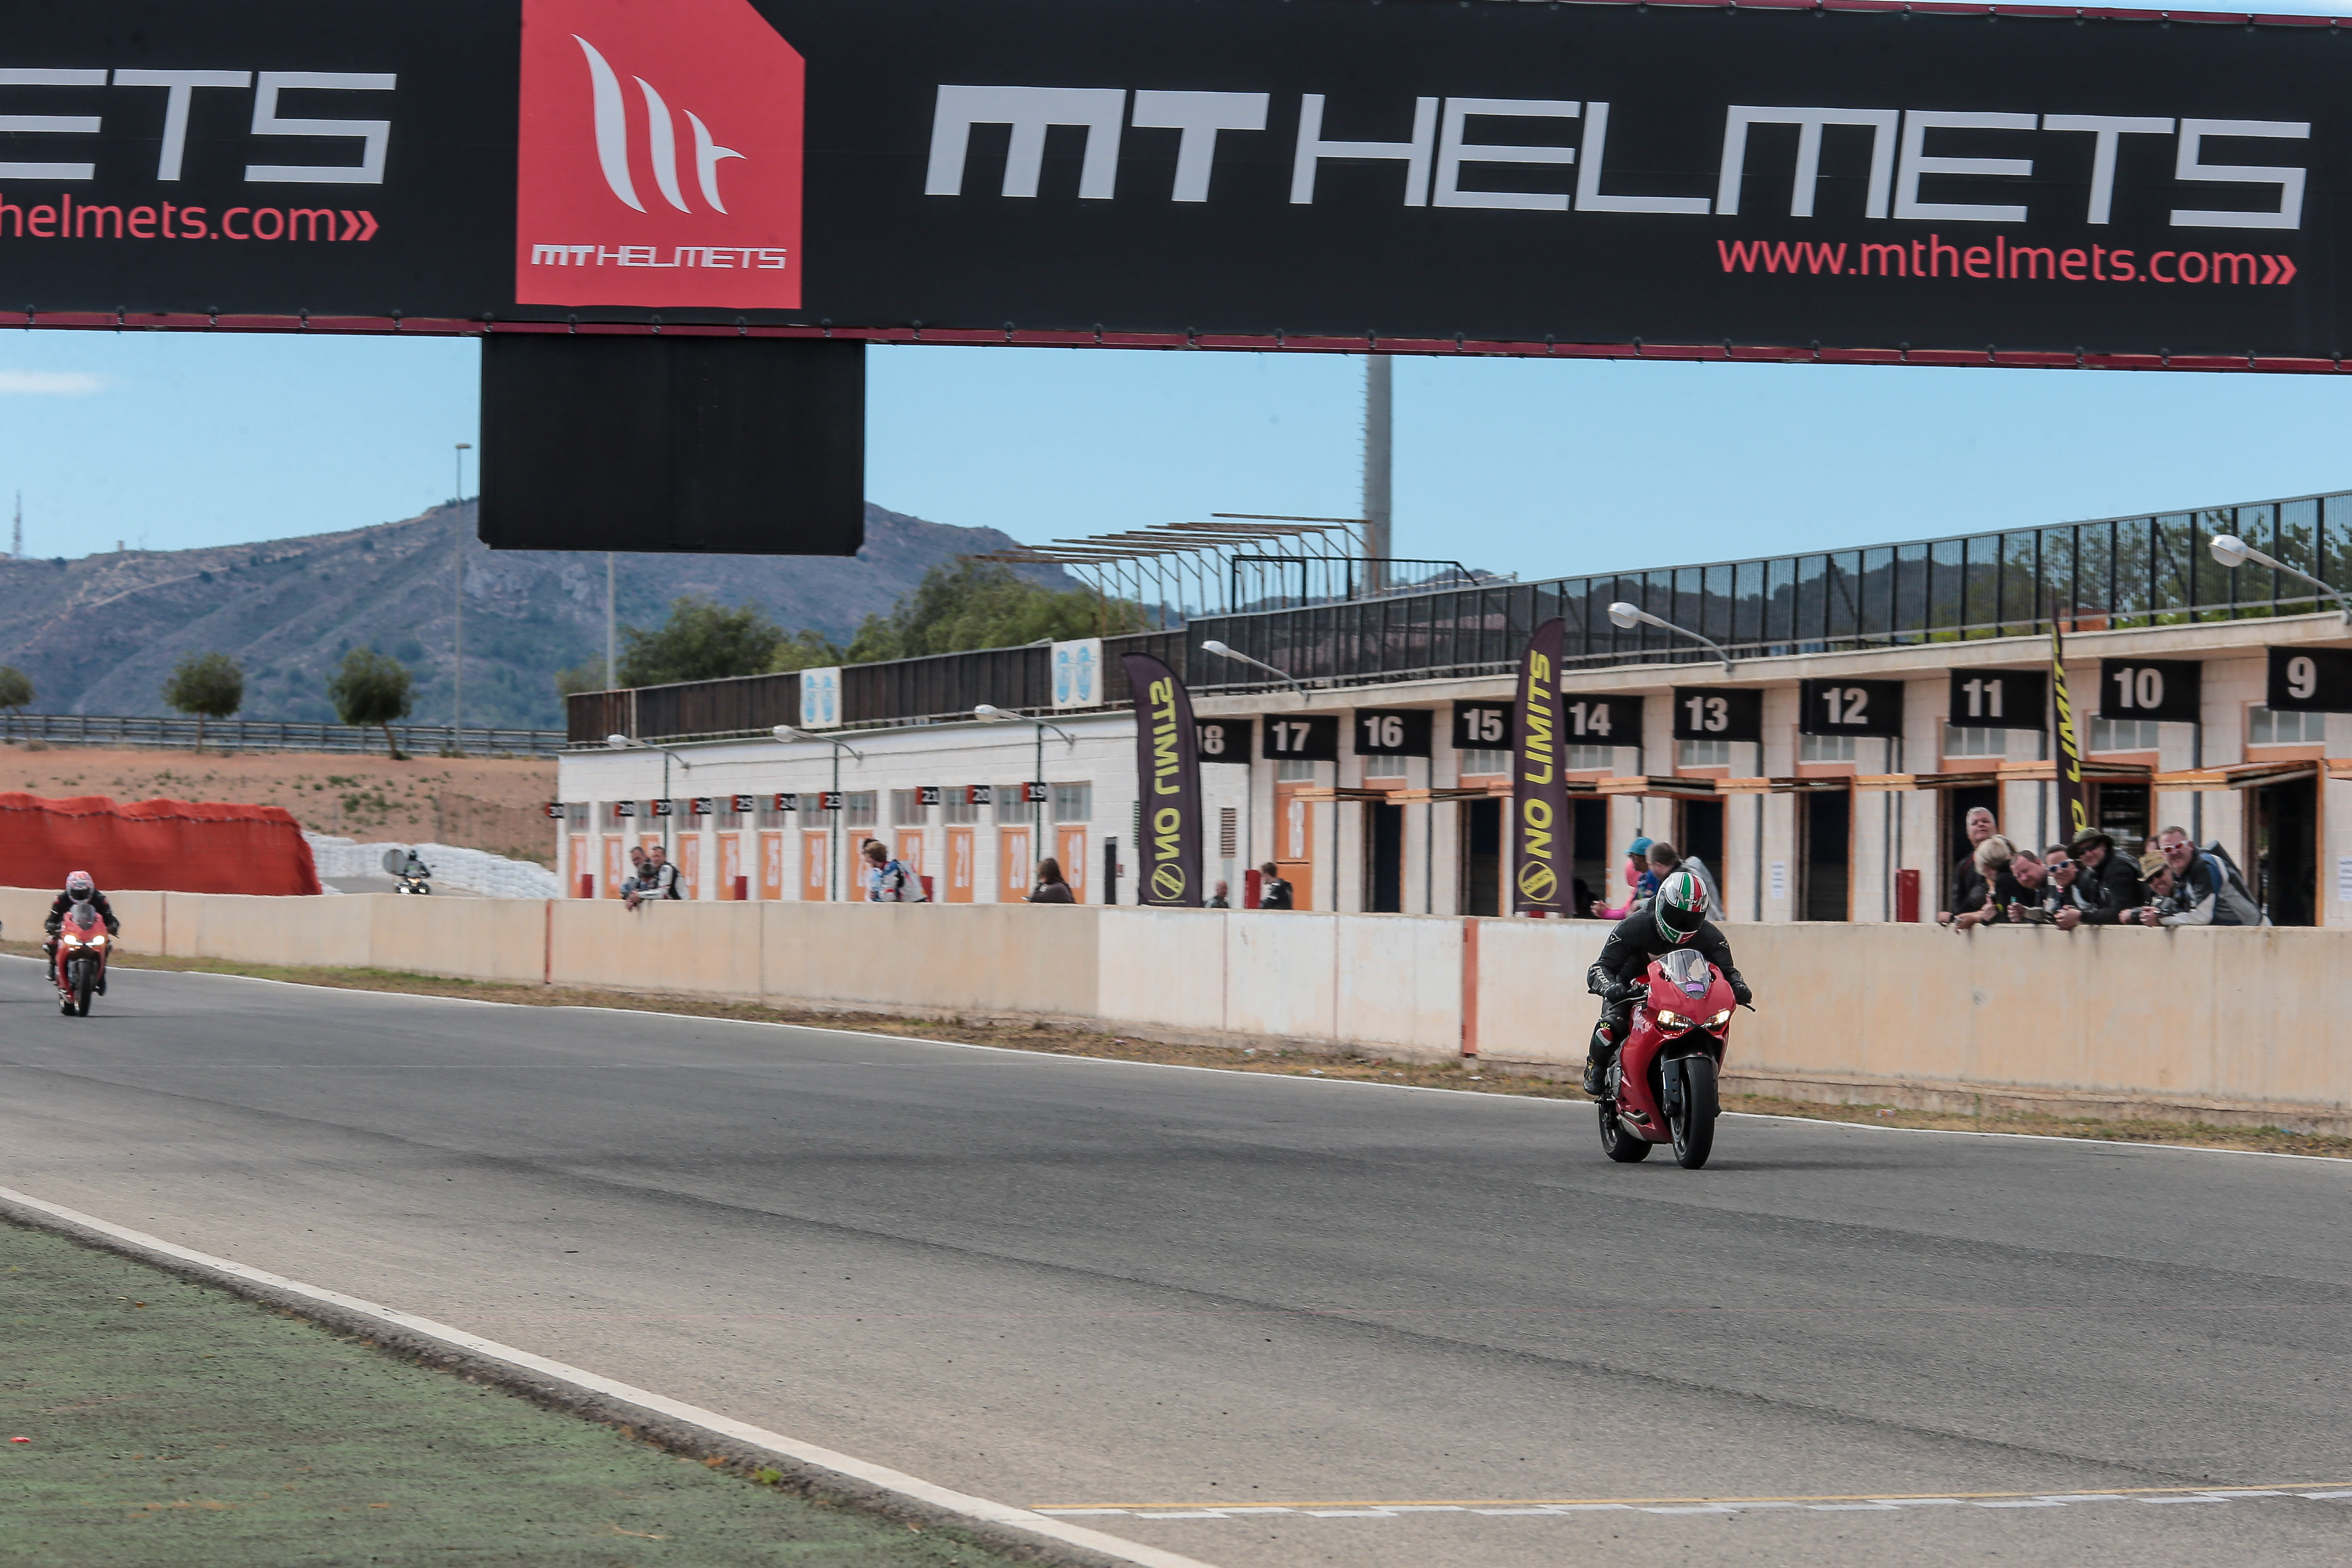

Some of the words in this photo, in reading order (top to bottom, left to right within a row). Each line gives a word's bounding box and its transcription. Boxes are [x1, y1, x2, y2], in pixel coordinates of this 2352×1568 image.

[1289, 93, 2310, 230] HELMETS
[1717, 234, 2258, 285] www.mthelmets.com
[2114, 668, 2163, 709] 10
[2287, 657, 2317, 699] 9
[1525, 650, 1553, 784] LIMITS
[1686, 696, 1729, 731] 13
[1822, 687, 1869, 724] 12
[1963, 679, 2003, 717] 11
[1272, 721, 1311, 751] 17
[1364, 716, 1404, 747] 16
[1463, 708, 1504, 741] 15
[1569, 702, 1612, 736] 14
[1524, 798, 1553, 859] NO
